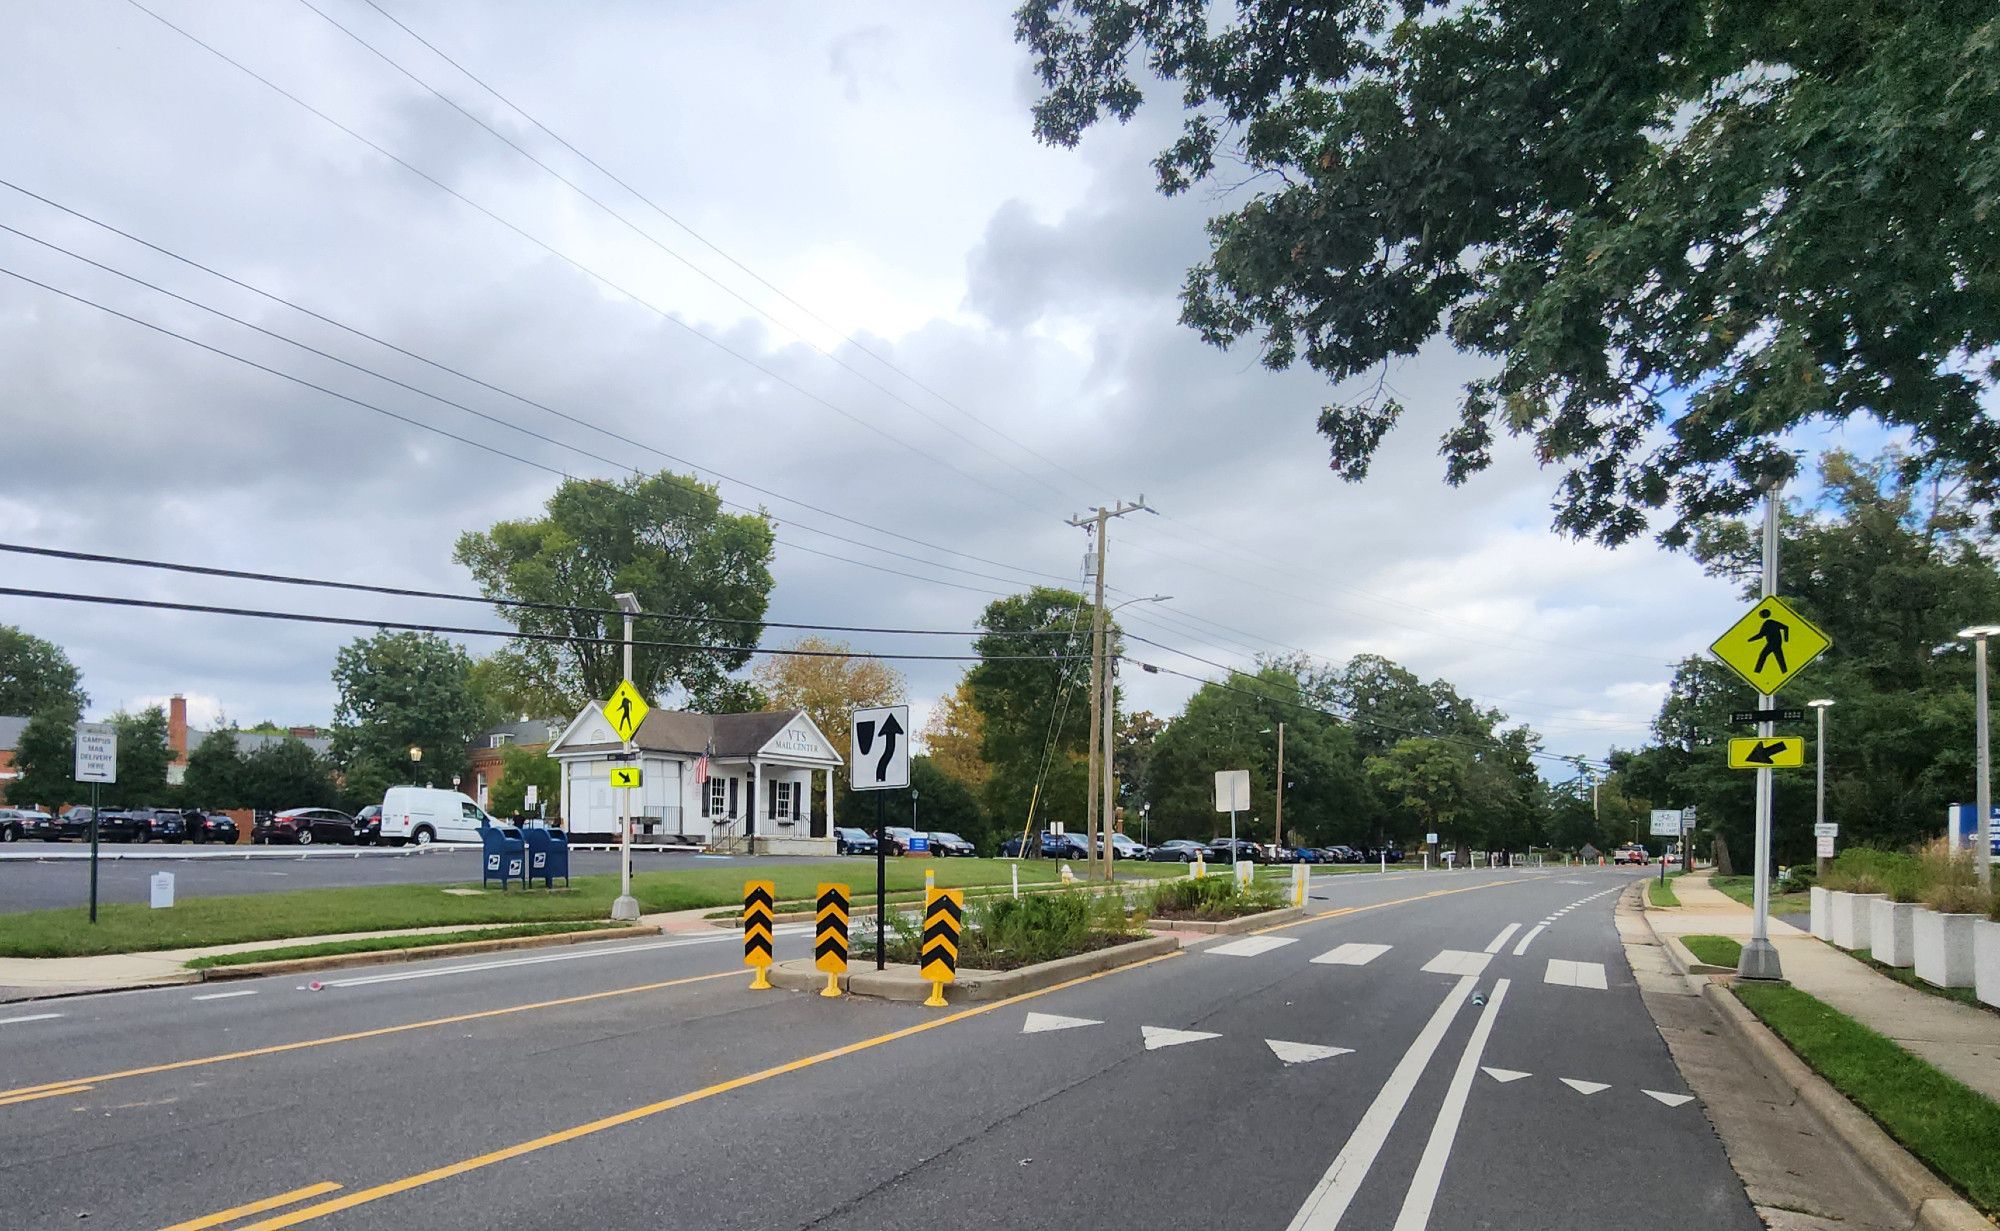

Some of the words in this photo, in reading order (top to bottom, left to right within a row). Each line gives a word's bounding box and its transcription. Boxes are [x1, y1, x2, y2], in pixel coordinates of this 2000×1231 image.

[81, 736, 111, 744] CAMPUS
[788, 729, 806, 742] VTS
[776, 740, 791, 750] MAIL
[793, 743, 818, 752] CENTER
[80, 753, 112, 761] DELIVERY
